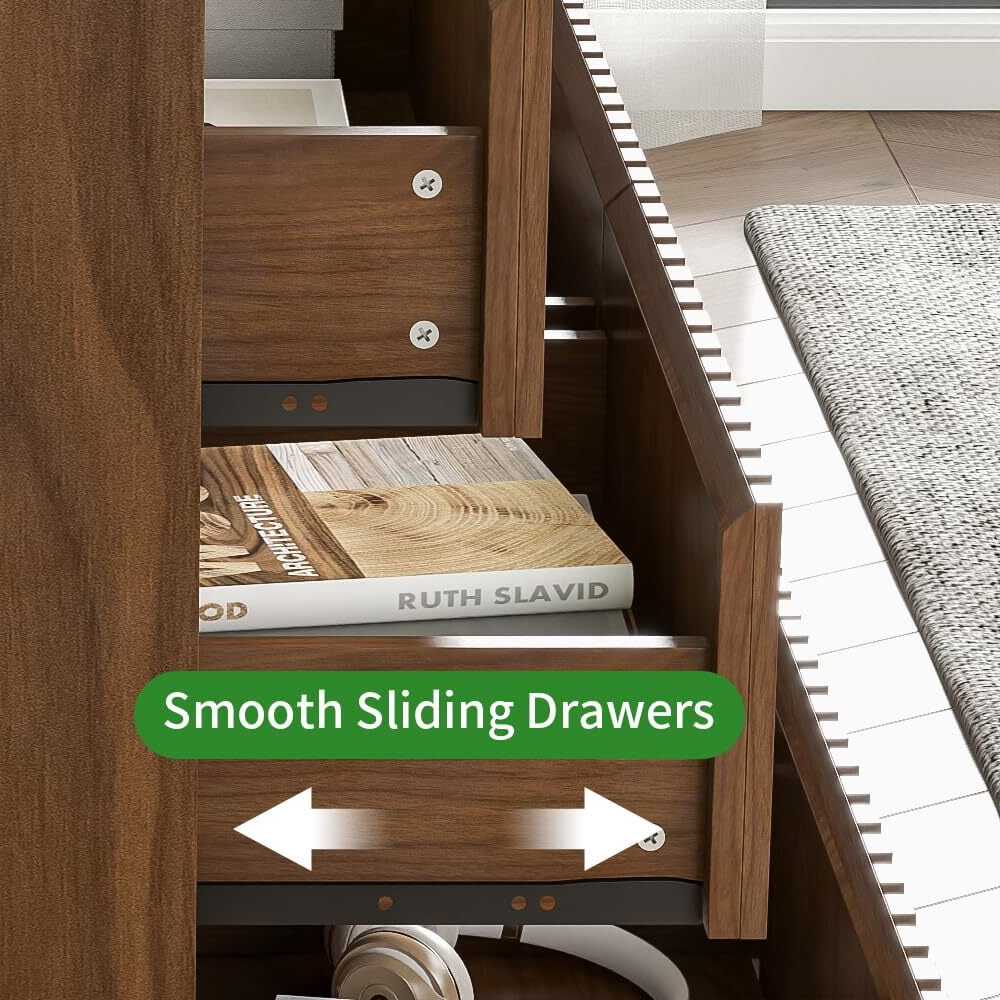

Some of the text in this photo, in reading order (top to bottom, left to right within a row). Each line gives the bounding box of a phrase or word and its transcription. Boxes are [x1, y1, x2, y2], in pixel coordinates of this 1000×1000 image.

[232, 493, 320, 577] ARCHITECTURE
[200, 581, 610, 622] OD RUTH SLAVID
